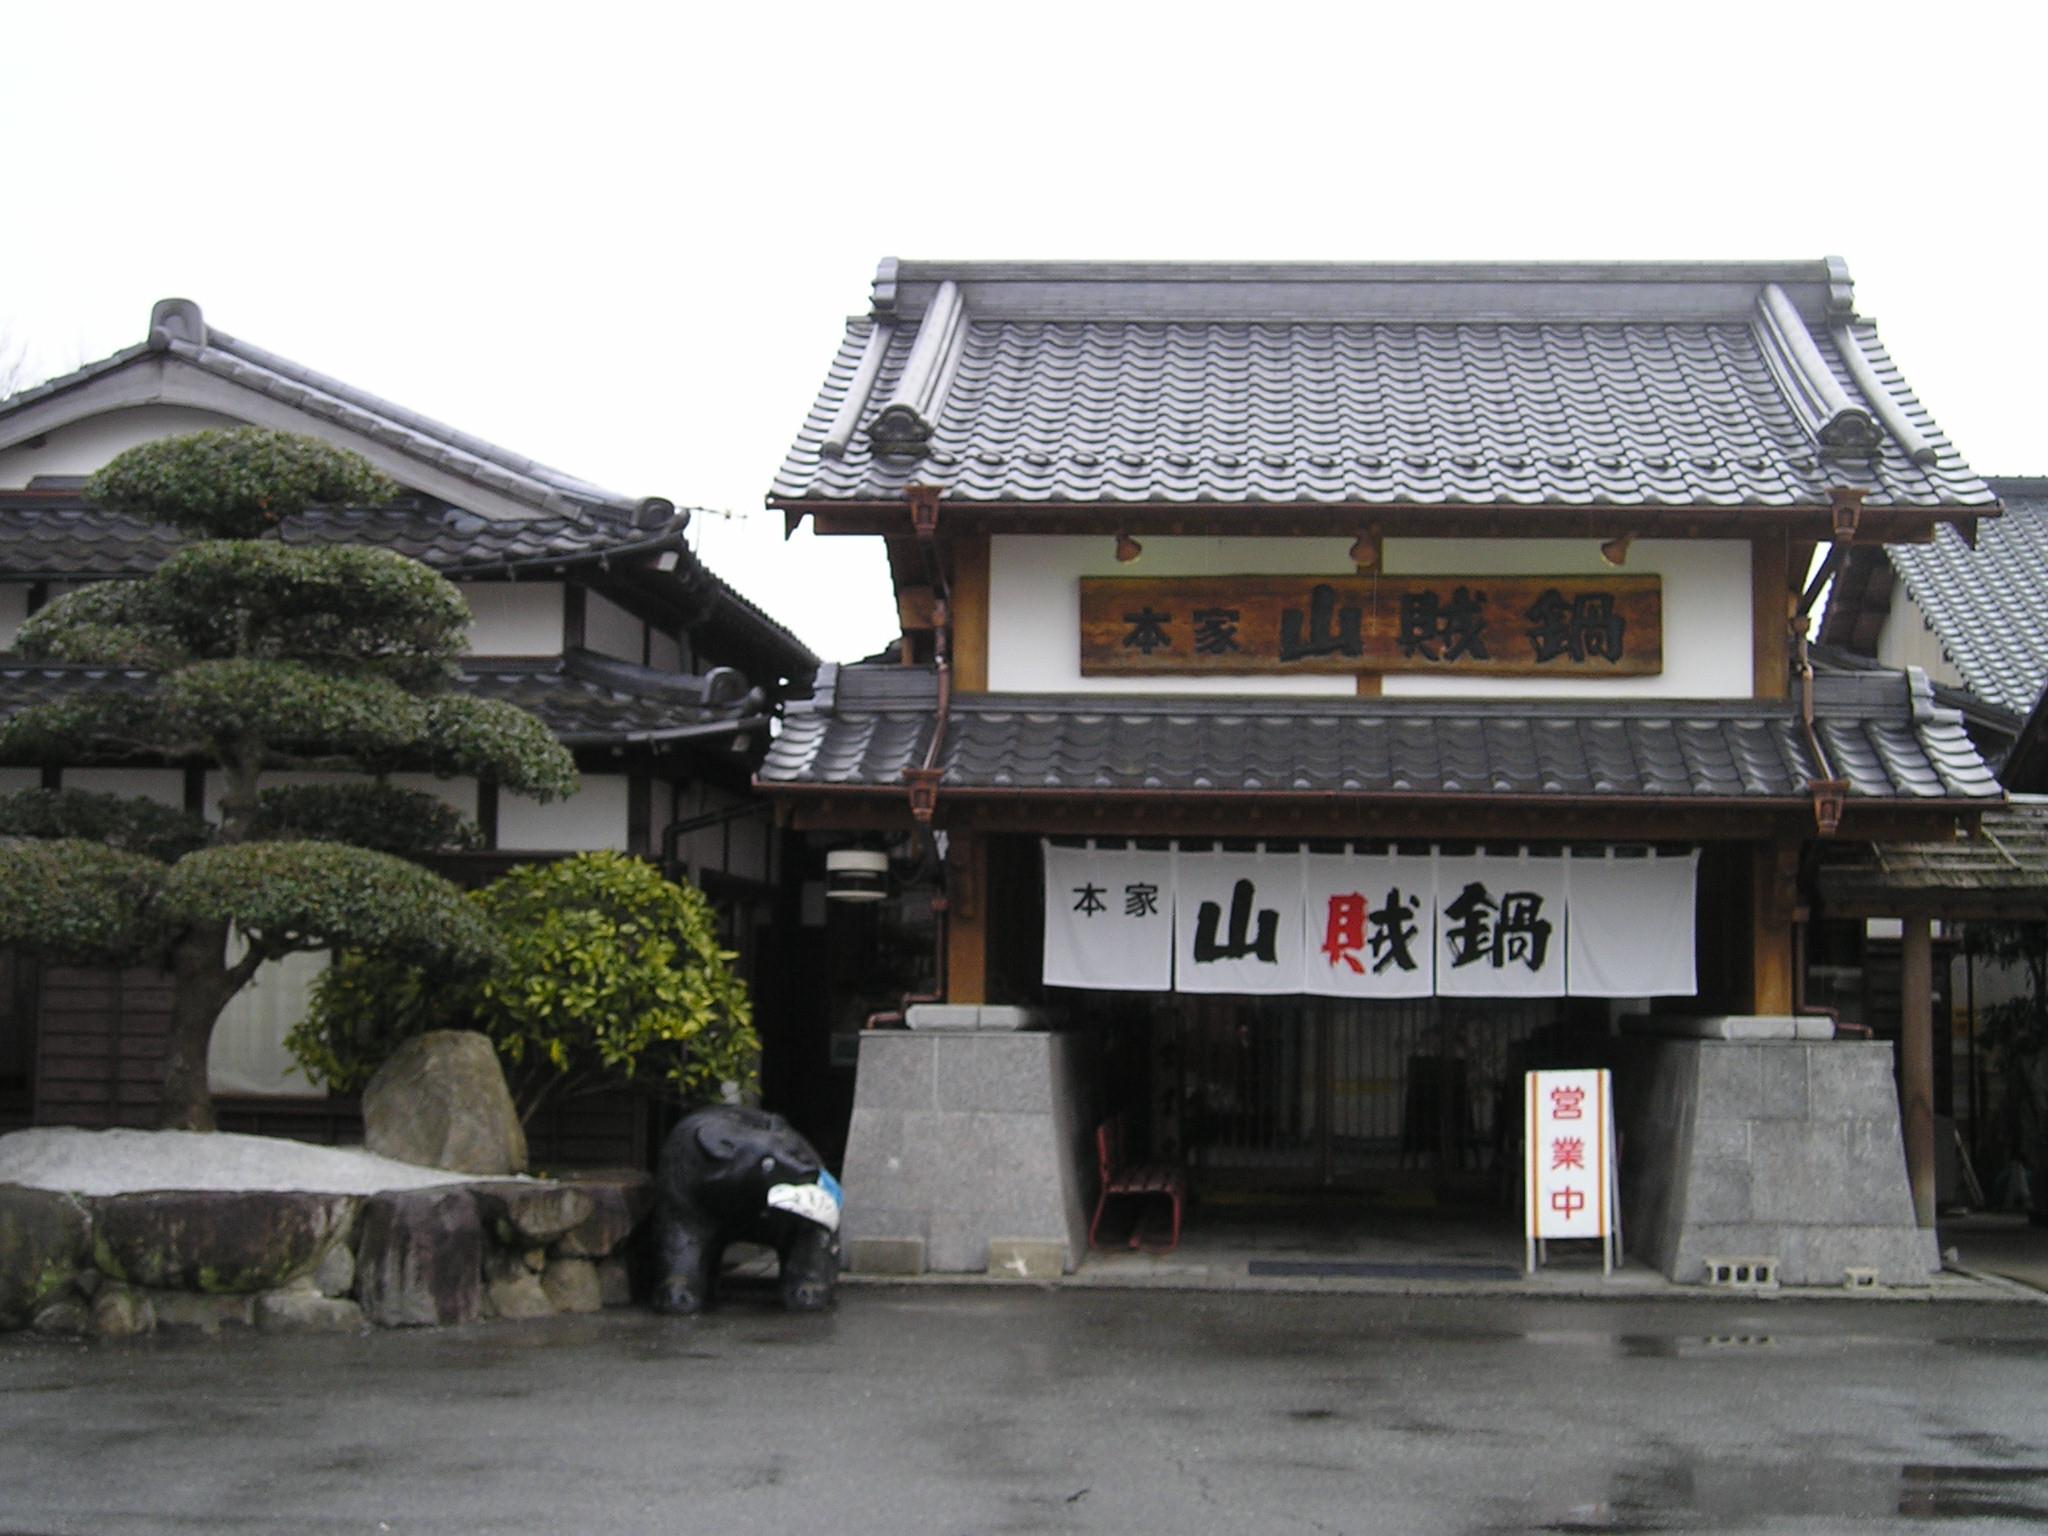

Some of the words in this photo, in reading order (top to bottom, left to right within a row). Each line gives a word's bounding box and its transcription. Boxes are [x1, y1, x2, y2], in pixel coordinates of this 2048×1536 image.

[1123, 606, 1240, 654] 本家
[1279, 583, 1626, 663] 山賊鍋
[1072, 882, 1158, 917] 本家
[1194, 878, 1552, 975] 山賊鍋
[1551, 1085, 1585, 1221] 営業中
